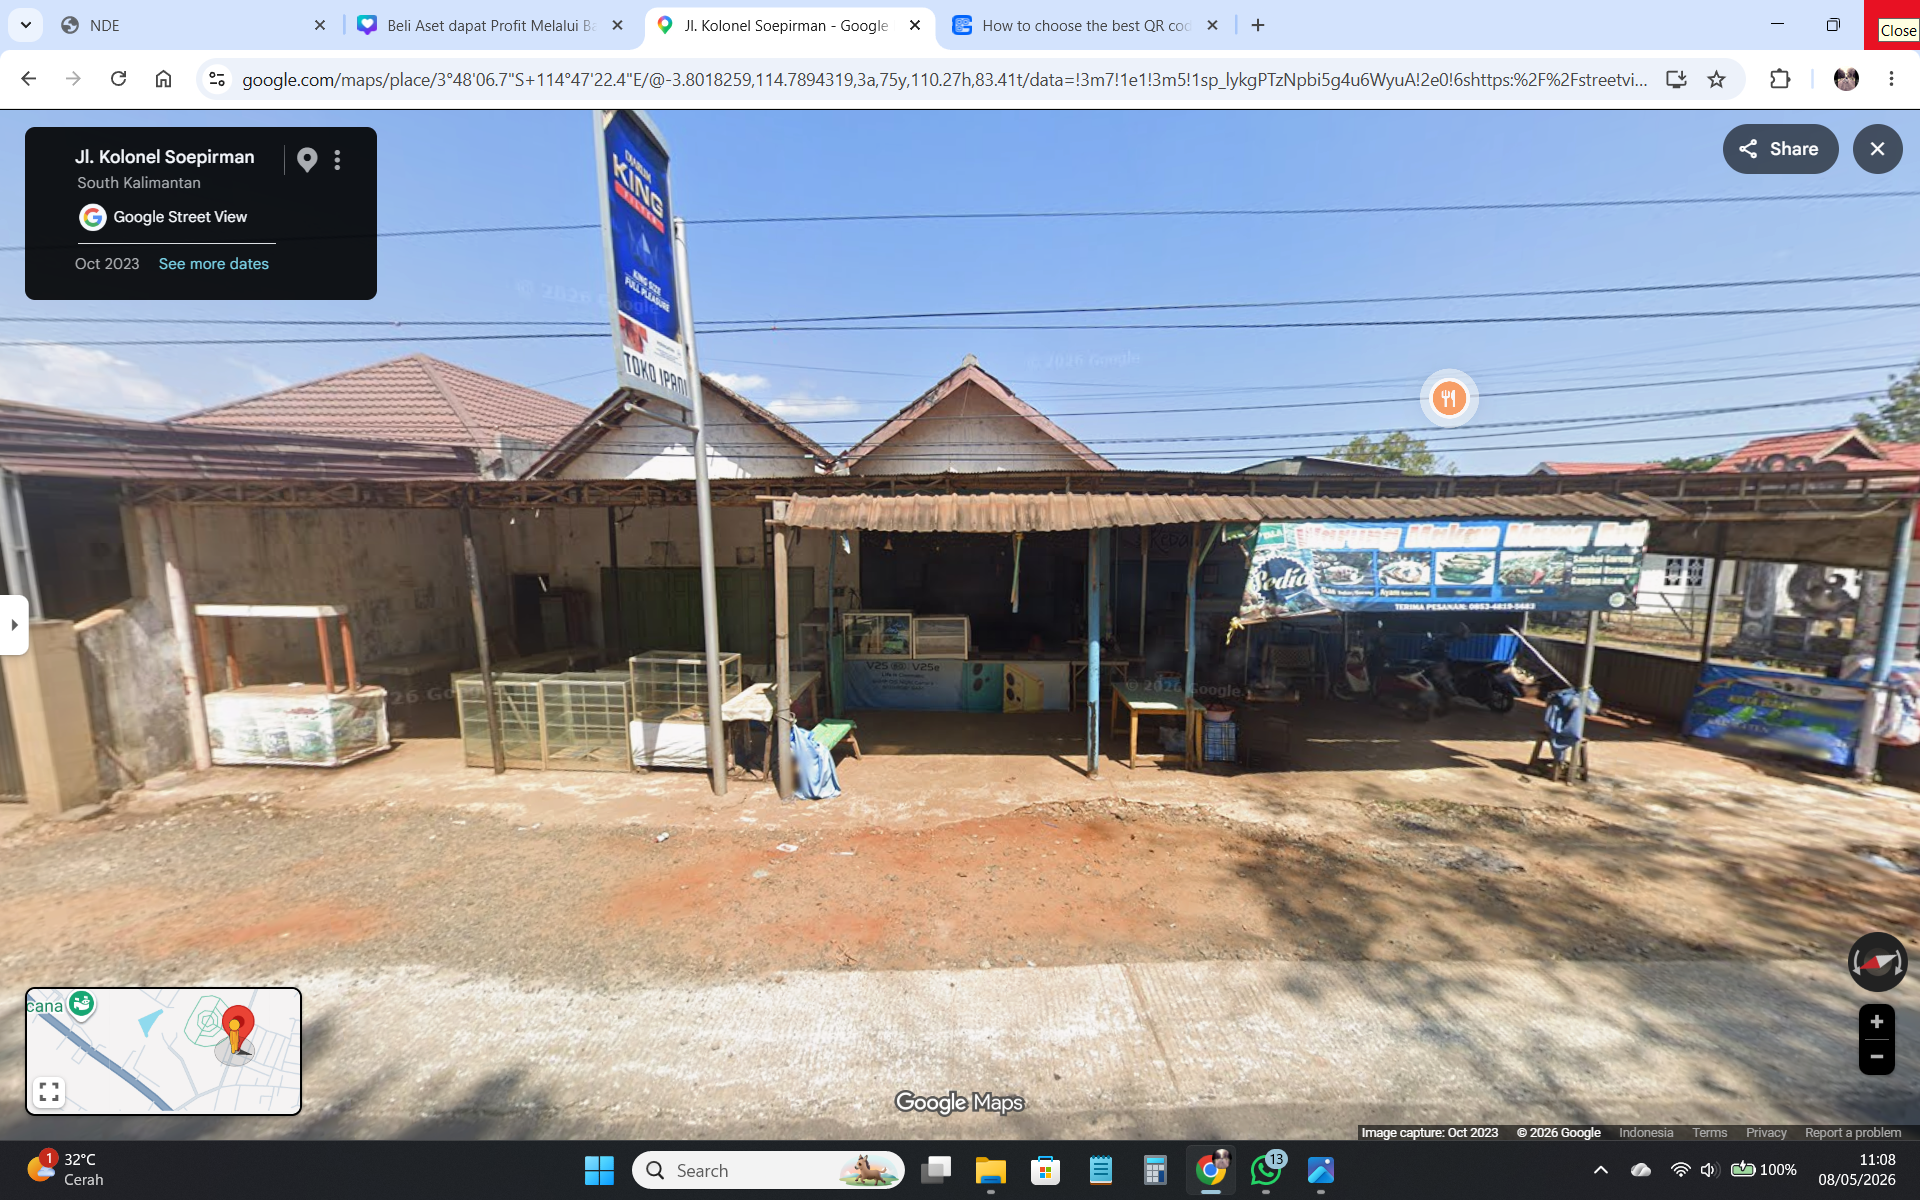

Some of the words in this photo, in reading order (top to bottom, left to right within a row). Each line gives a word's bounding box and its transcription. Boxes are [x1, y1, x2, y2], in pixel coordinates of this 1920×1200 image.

[91, 20, 119, 31] NDE
[389, 20, 410, 32] Beli
[415, 20, 444, 32] Aset
[449, 20, 486, 34] dapat
[492, 20, 526, 32] Profit
[532, 20, 578, 32] Melalui
[685, 20, 698, 32] Jl.
[702, 20, 750, 32] Kolonel
[756, 20, 826, 34] Soepirman
[841, 20, 888, 34] Google
[983, 20, 1013, 32] How
[1017, 21, 1031, 32] to
[1035, 20, 1082, 32] choose
[1086, 20, 1107, 32] the
[1113, 20, 1140, 32] best
[1144, 20, 1165, 33] QR
[1881, 25, 1917, 36] Close
[1771, 141, 1818, 156] Share
[75, 149, 95, 165] Jl.
[100, 149, 160, 165] Kolonel
[165, 149, 254, 167] Soepirman
[78, 176, 119, 189] South
[124, 176, 201, 189] Kalimantan
[612, 152, 664, 219] KING
[114, 210, 164, 227] Google
[168, 210, 211, 224] Street
[214, 210, 247, 224] View
[75, 258, 100, 270] Oct
[105, 258, 140, 270] 2023
[159, 258, 186, 270] See
[191, 261, 225, 270] more
[230, 258, 269, 270] dates
[624, 276, 641, 294] FULL
[623, 351, 657, 383] TOKO
[1252, 567, 1310, 593] Sedia
[1395, 603, 1424, 611] TERIMA
[1426, 603, 1467, 611] PESANAN:
[27, 1002, 63, 1012] cana
[46, 1153, 52, 1163] 1
[65, 1154, 95, 1166] 32°C
[1270, 1153, 1283, 1165] 13
[1861, 1154, 1896, 1166] 11:08
[678, 1164, 728, 1178] Search
[1760, 1164, 1797, 1176] 100%
[65, 1174, 104, 1186] Cerah
[1819, 1173, 1896, 1187] 08/05/2026
